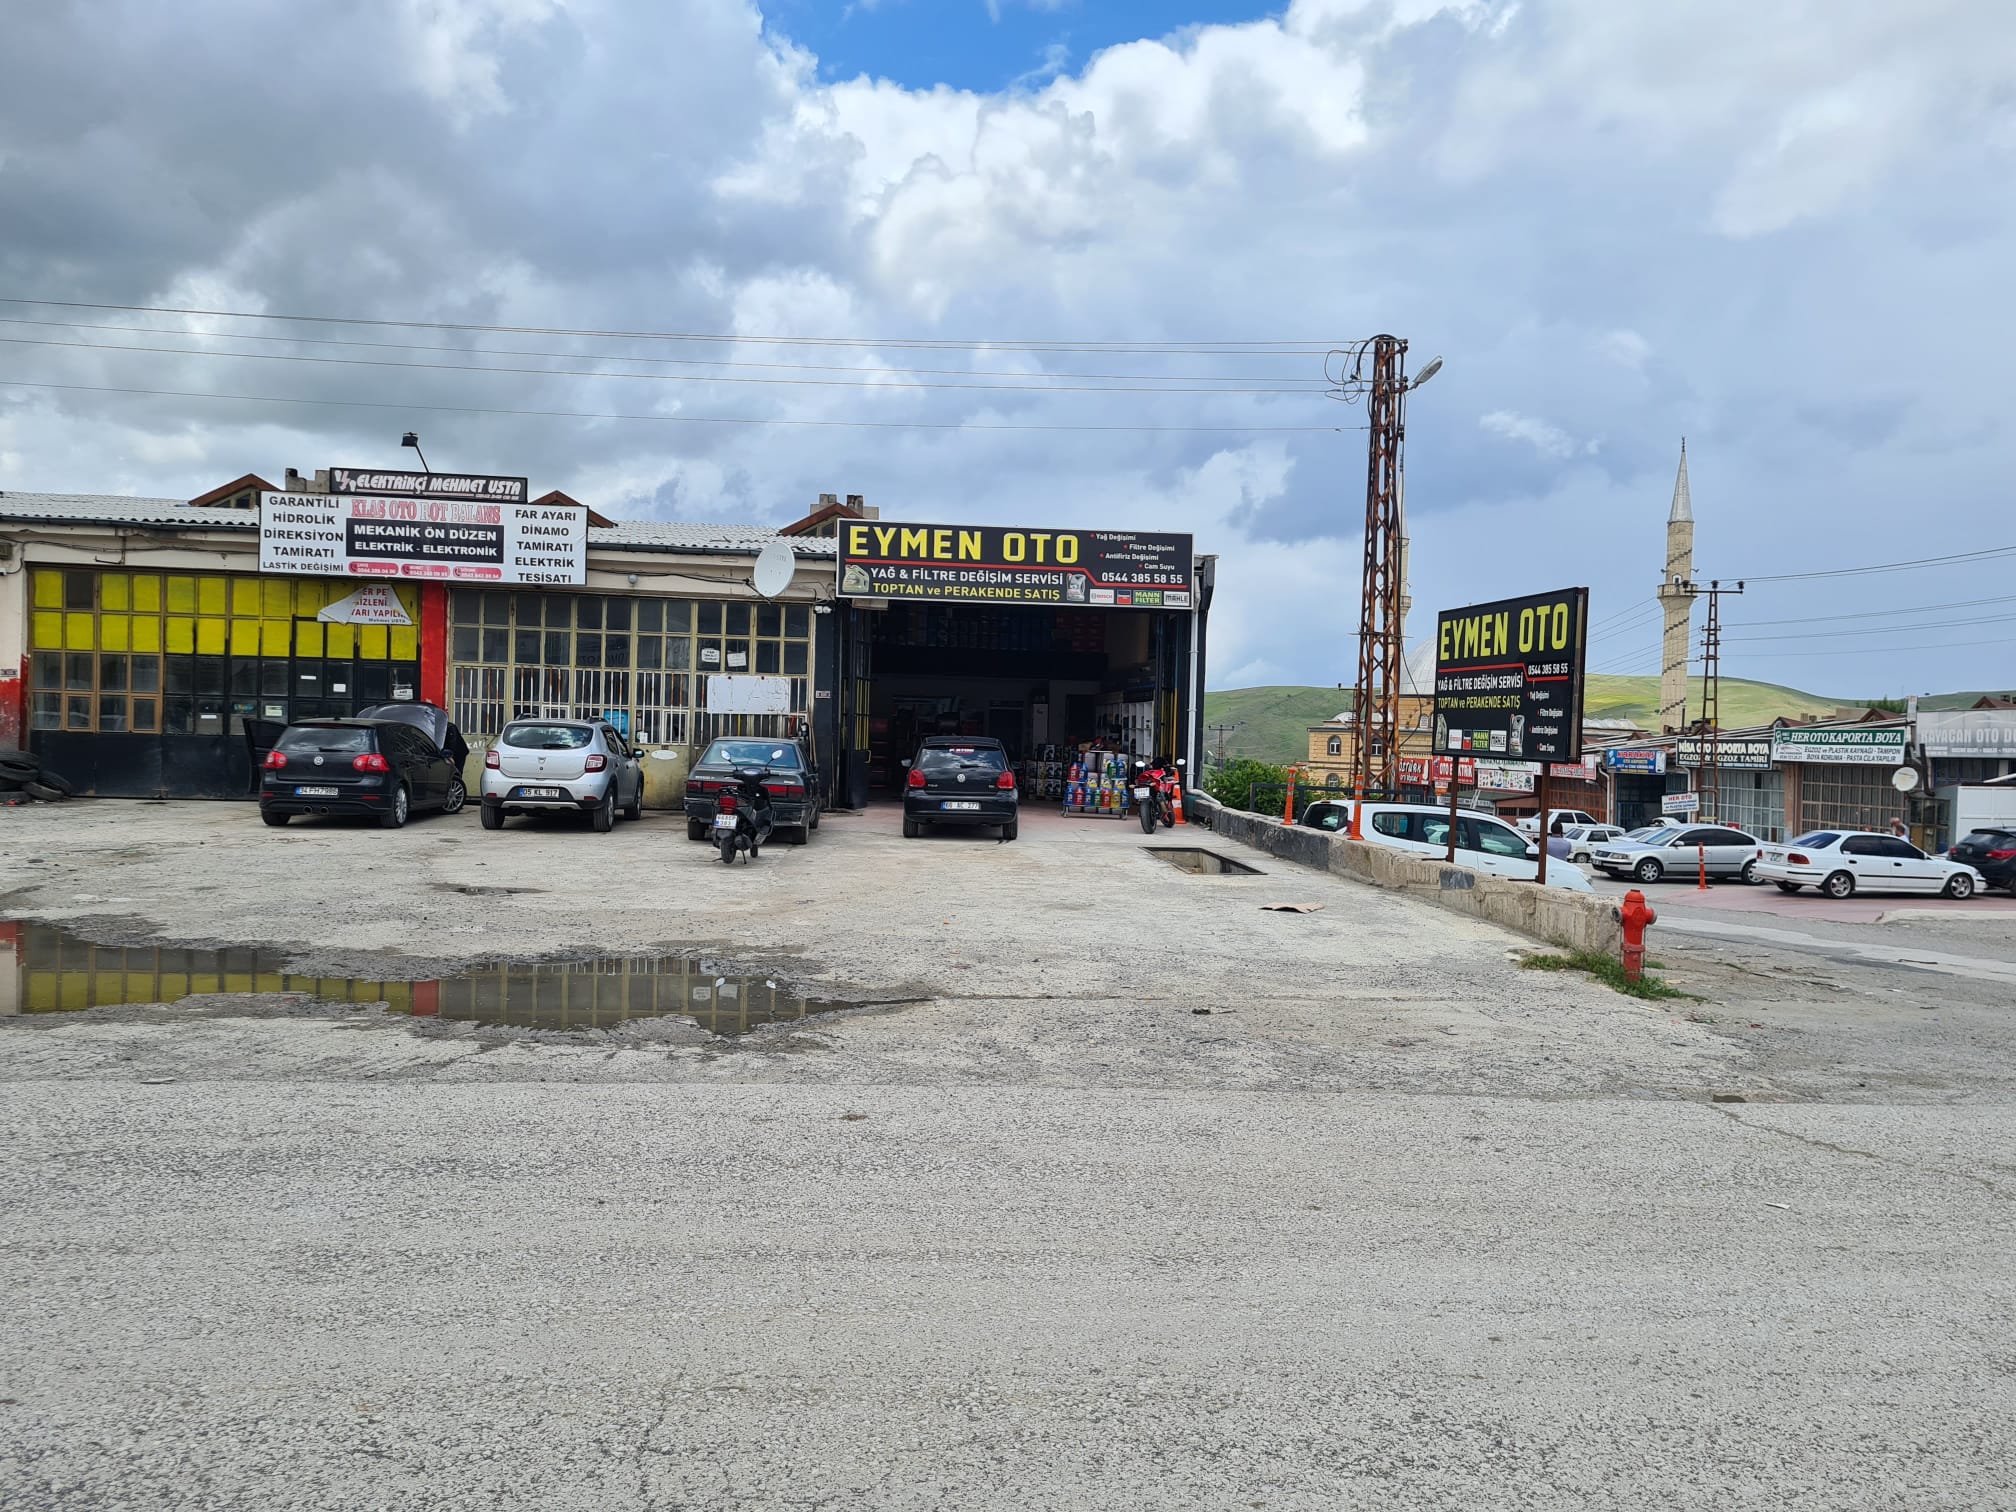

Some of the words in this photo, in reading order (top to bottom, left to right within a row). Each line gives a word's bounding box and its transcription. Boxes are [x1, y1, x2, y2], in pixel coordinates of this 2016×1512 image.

[429, 477, 486, 493] MEHMET
[488, 480, 522, 495] USTA
[269, 496, 339, 509] GARANTİLİ
[389, 500, 417, 520] OTO
[515, 509, 538, 519] FAR
[541, 511, 576, 521] AYARI
[273, 511, 336, 525] HİDROLİK
[264, 527, 344, 542] DİREKSİYON
[354, 524, 421, 538] MEKANİK
[424, 526, 445, 539] ÖN
[450, 528, 497, 541] DÜZEN
[521, 524, 569, 537] DİNAMO
[273, 545, 334, 558] TAMİRATI
[354, 541, 414, 553] ELEKTRİK
[422, 544, 497, 556] ELEKTRONİK
[516, 541, 573, 552] TAMİRATI
[849, 525, 982, 562] EYMEN
[1003, 532, 1079, 565] OTO
[263, 561, 298, 570] LASTİK
[515, 557, 575, 568] ELEKTRİK
[517, 571, 572, 583] TESİSATI
[870, 566, 896, 579] YAĞ
[899, 570, 908, 580] &
[912, 567, 957, 581] FİLTRE
[960, 570, 1011, 585] DEĞİŞİM
[1015, 572, 1063, 586] SERVİSİ
[1101, 572, 1128, 582] 0544
[1131, 573, 1151, 583] 385
[1153, 574, 1167, 583] 58
[1170, 574, 1183, 584] 55
[872, 582, 924, 595] TOPTAN
[927, 586, 942, 595] ve
[944, 586, 1021, 599] PERAKENDE
[1024, 588, 1061, 601] SATIŞ
[1439, 611, 1509, 661] EYMEN
[1518, 602, 1569, 653] OTO
[1527, 665, 1541, 676] 0544
[1541, 663, 1552, 675] 385
[1560, 662, 1568, 674] 55
[1437, 676, 1448, 691] YAĞ
[1453, 675, 1473, 690] FİLTRE
[1473, 674, 1498, 691] DEĞİŞİM
[1498, 672, 1523, 689] SERVİSİ
[1437, 697, 1459, 709] TOPTAN
[1459, 700, 1465, 709] ve
[1466, 696, 1502, 709] PERAKENDE
[1502, 695, 1521, 710] SATIŞ
[1473, 730, 1489, 740] MANN
[1790, 732, 1810, 742] HER
[1810, 732, 1829, 743] OTO
[1828, 732, 1873, 743] KAPORTA
[1874, 732, 1902, 743] BOYA
[1976, 728, 1999, 743] OTO
[1748, 743, 1770, 754] BOYA
